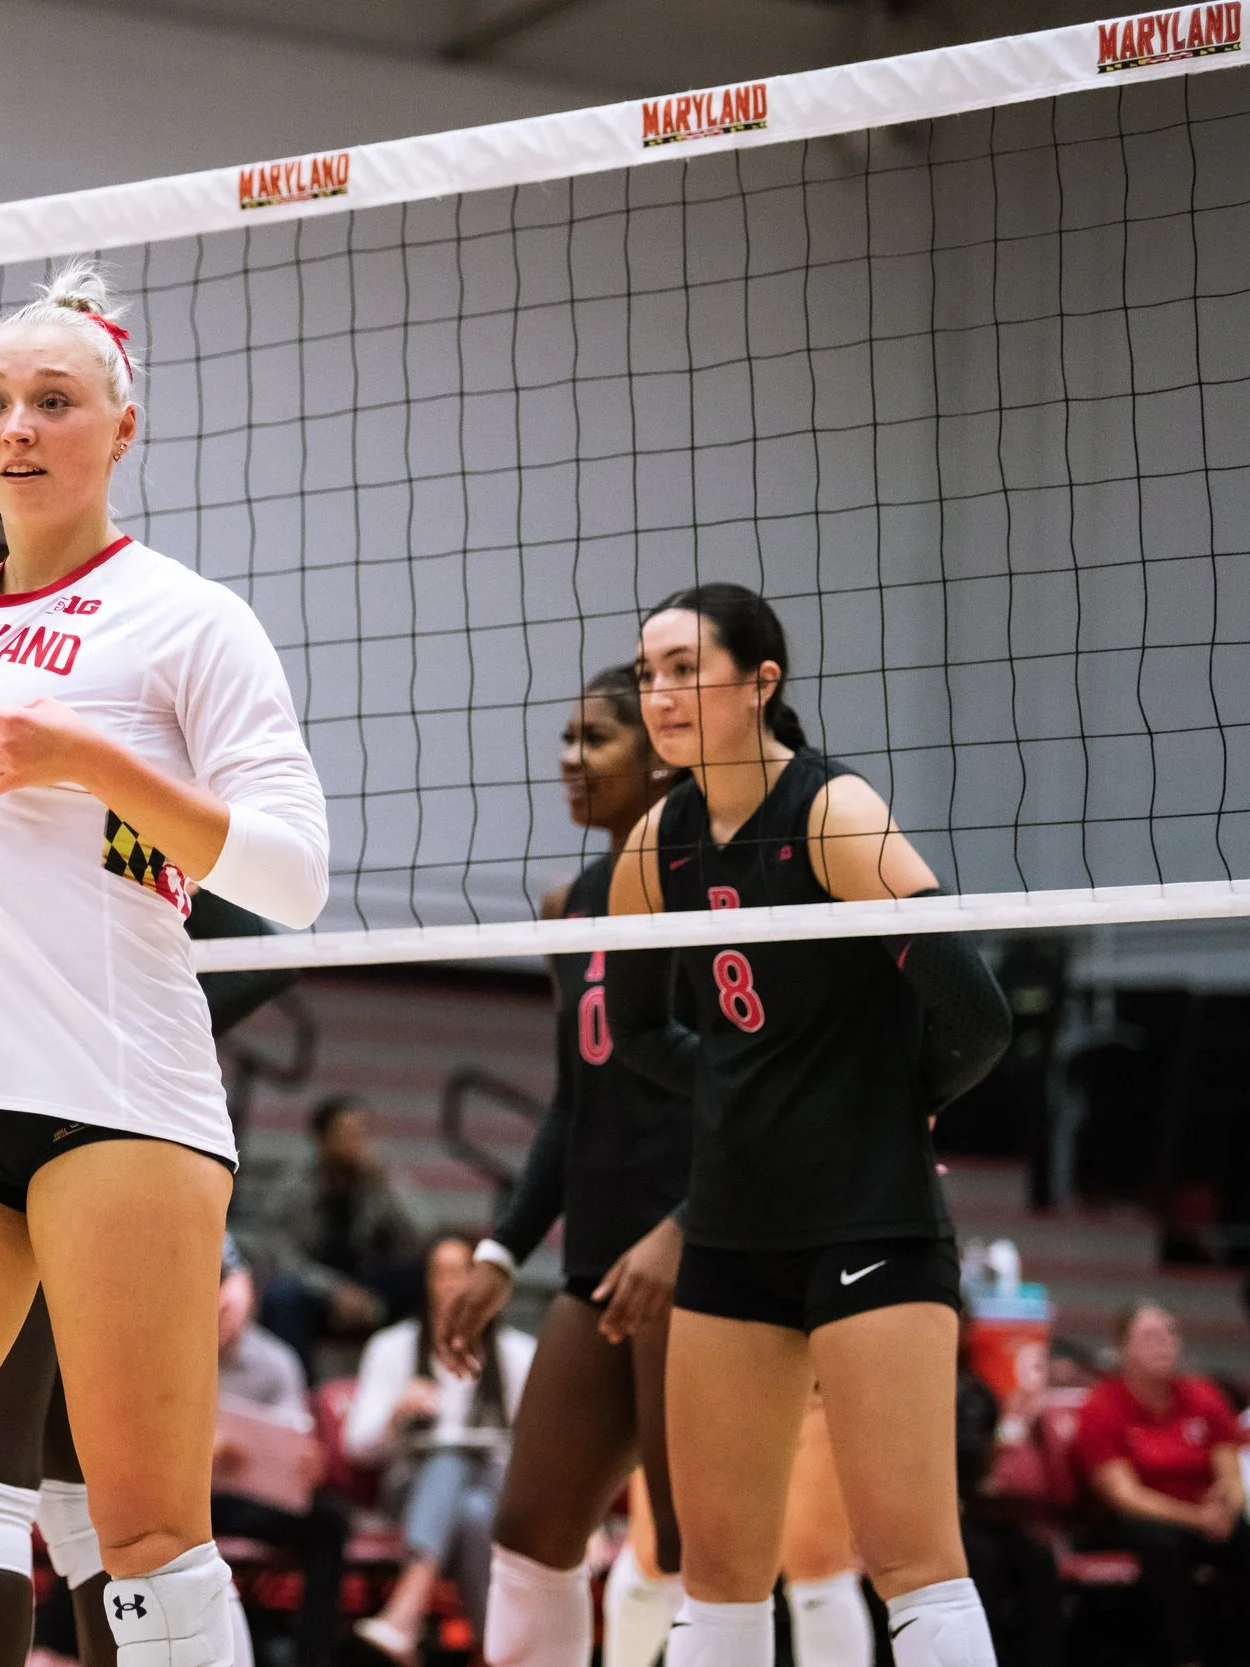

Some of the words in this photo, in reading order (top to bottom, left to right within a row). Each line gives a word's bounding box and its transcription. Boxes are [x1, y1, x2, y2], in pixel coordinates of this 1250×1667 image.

[1098, 1, 1242, 64] MARYLAND
[642, 83, 767, 138] MARYLAND
[239, 153, 349, 202] MARYLAND
[713, 949, 765, 1034] 8
